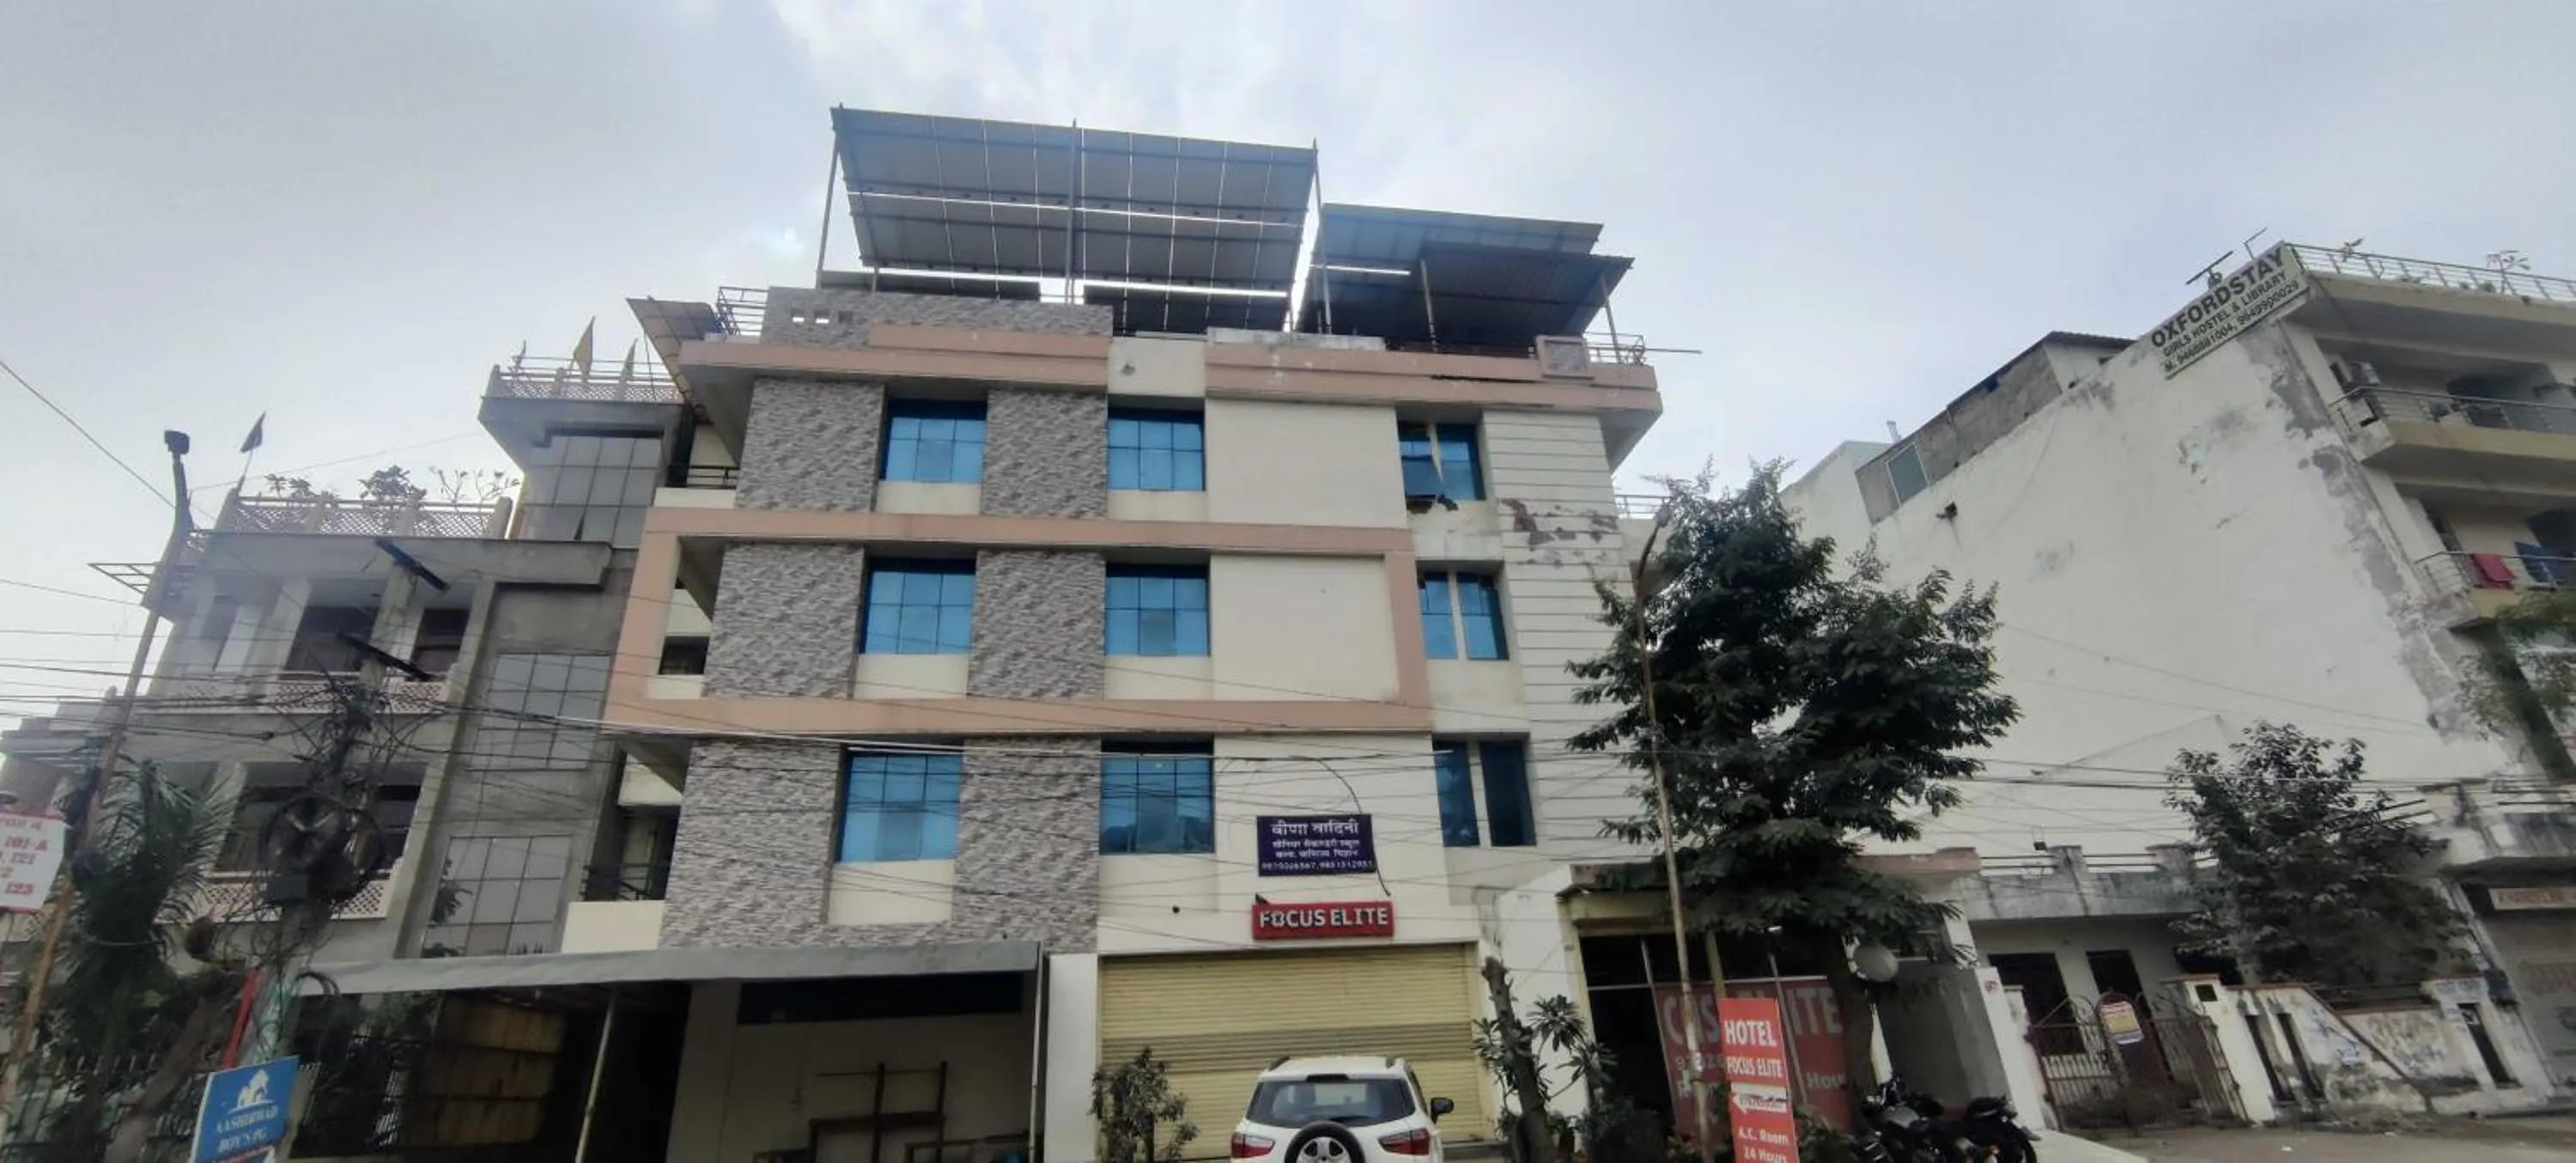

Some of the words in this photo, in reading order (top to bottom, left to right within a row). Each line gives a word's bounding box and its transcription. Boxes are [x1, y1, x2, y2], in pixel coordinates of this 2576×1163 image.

[2151, 247, 2284, 347] OXFORDSTAY
[2163, 335, 2191, 357] GIRLS
[2192, 310, 2230, 338] HOSTEL
[2232, 301, 2240, 314] &
[2240, 271, 2287, 306] LIBRARY
[1271, 819, 1309, 836] वीणा
[1311, 817, 1359, 836] वादिनी
[1260, 909, 1326, 929] FOCUS
[1330, 906, 1388, 926] ELITE
[1723, 1020, 1777, 1046] HOTEL
[1727, 1056, 1756, 1076] FOCUS
[1757, 1057, 1784, 1080] ELITE
[1739, 1126, 1758, 1142] A.C.
[1759, 1128, 1789, 1146] Room
[1744, 1145, 1758, 1160] 24
